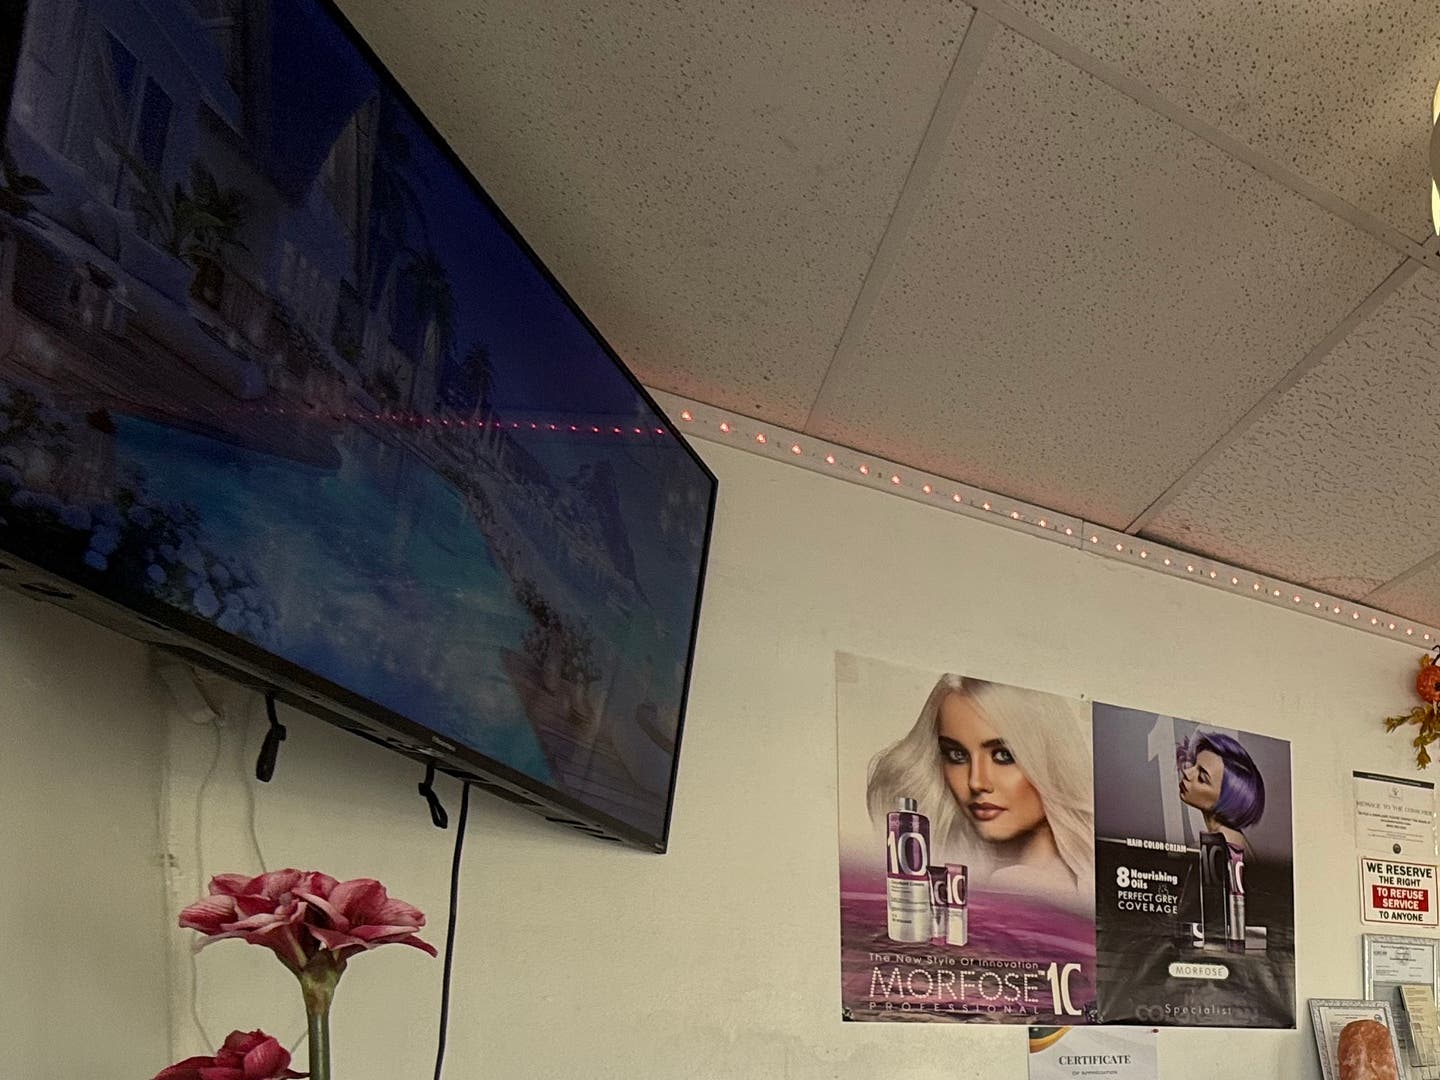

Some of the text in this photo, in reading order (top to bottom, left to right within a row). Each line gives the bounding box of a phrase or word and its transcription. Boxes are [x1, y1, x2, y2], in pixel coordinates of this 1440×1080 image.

[1126, 838, 1187, 853] HAIR COLOR CREAM
[887, 831, 928, 876] 10
[1366, 861, 1433, 878] WE RESERVE
[1116, 866, 1178, 888] 8 Nourishing
[1378, 875, 1421, 887] THE RIGHT
[1130, 879, 1148, 890] Oils
[1117, 890, 1178, 904] PERFECT GREY
[1376, 887, 1425, 900] TO REFUSE
[1117, 901, 1178, 915] COVERAGE
[1382, 898, 1420, 910] SERVICE
[1378, 910, 1424, 921] TO ANYONE
[869, 952, 1039, 970] The New Style Of Innovation
[1175, 966, 1225, 977] MORFOSE
[869, 966, 1039, 1003] MORFOSE
[869, 1001, 1040, 1015] PROFESSIONAL
[1164, 1002, 1232, 1017] Specialist
[1058, 1054, 1132, 1066] CERTIFICATE
